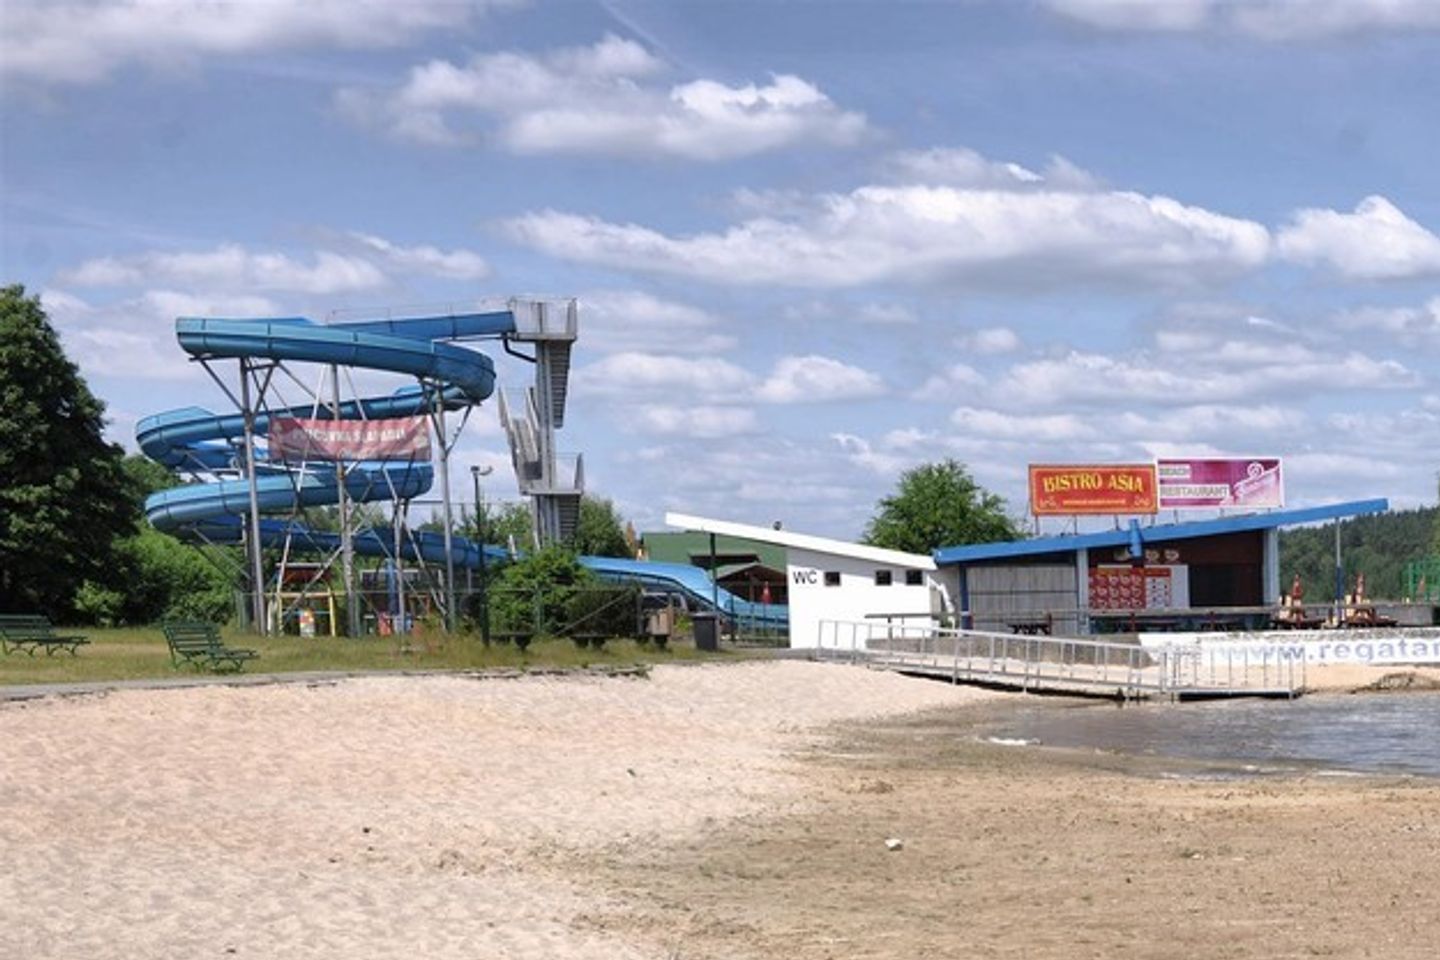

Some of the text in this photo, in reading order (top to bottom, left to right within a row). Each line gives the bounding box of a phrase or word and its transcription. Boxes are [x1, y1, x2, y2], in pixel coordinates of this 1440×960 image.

[1043, 473, 1144, 493] BISTRO ASIA
[1159, 485, 1228, 498] RESTAURANT
[793, 570, 818, 585] WC
